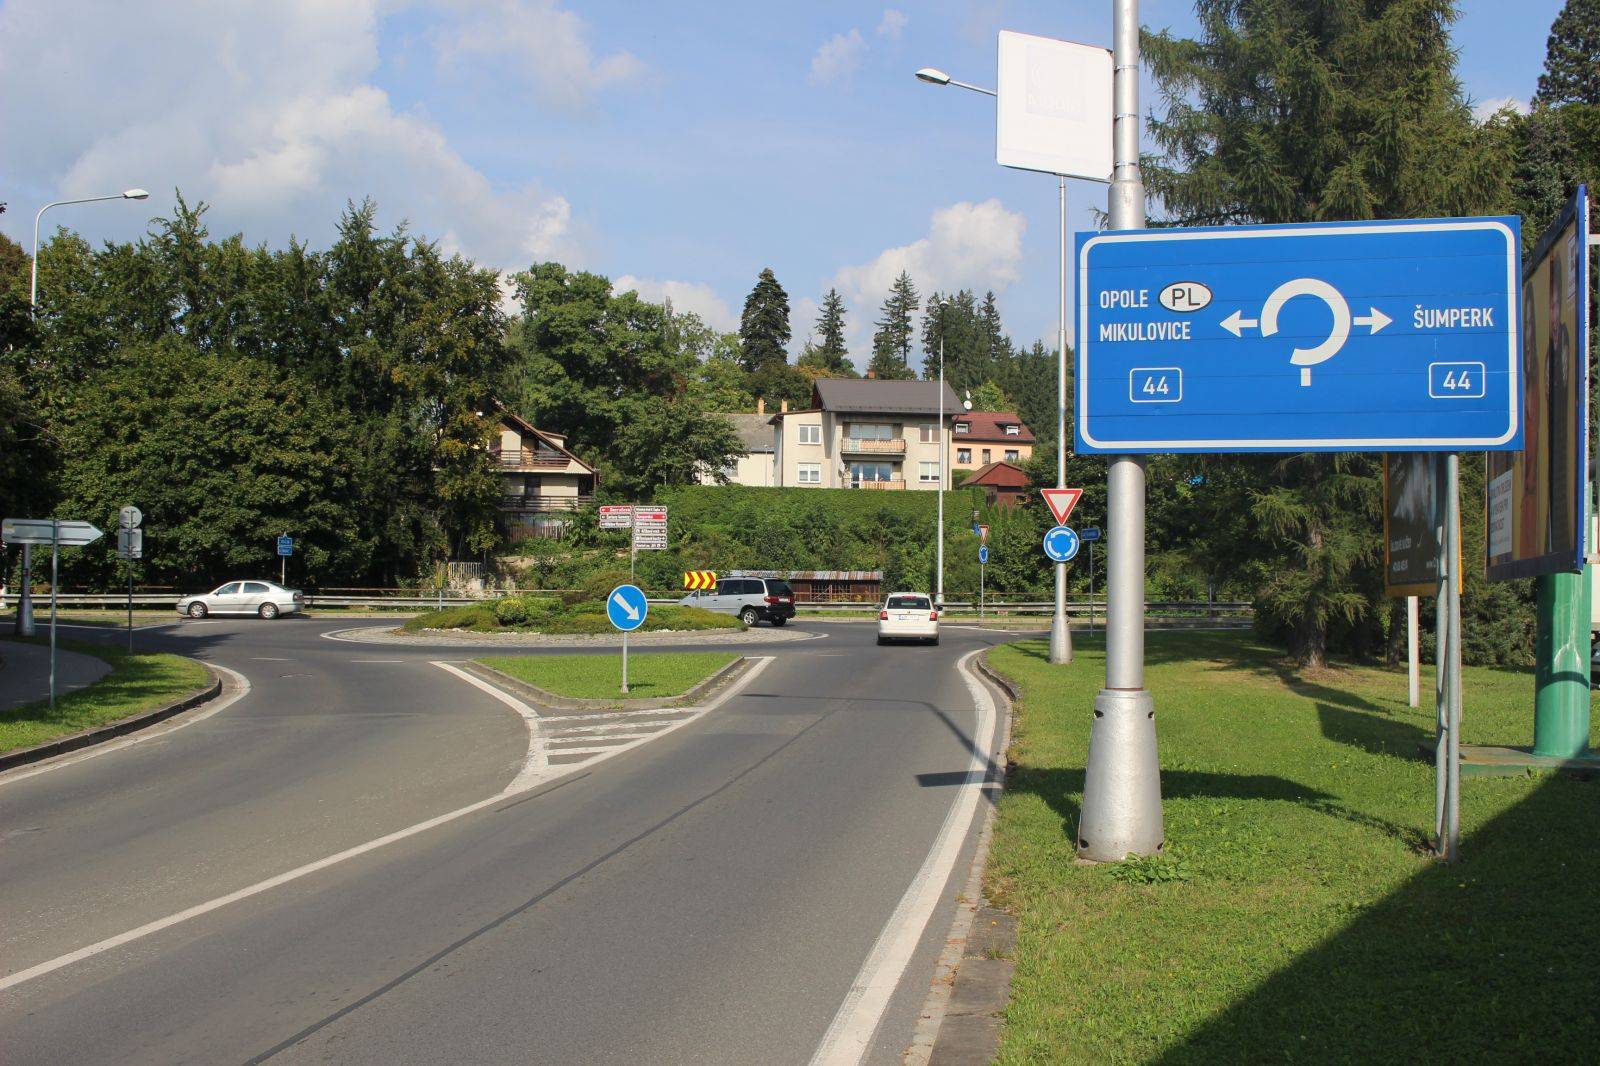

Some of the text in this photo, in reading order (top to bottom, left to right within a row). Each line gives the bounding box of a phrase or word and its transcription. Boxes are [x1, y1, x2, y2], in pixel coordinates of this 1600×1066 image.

[1100, 288, 1201, 309] OPOLE PL
[1413, 304, 1493, 329] ŠUMPERK
[1100, 322, 1191, 342] MIKULOVICE
[1143, 377, 1168, 394] 44
[1444, 371, 1470, 389] 44
